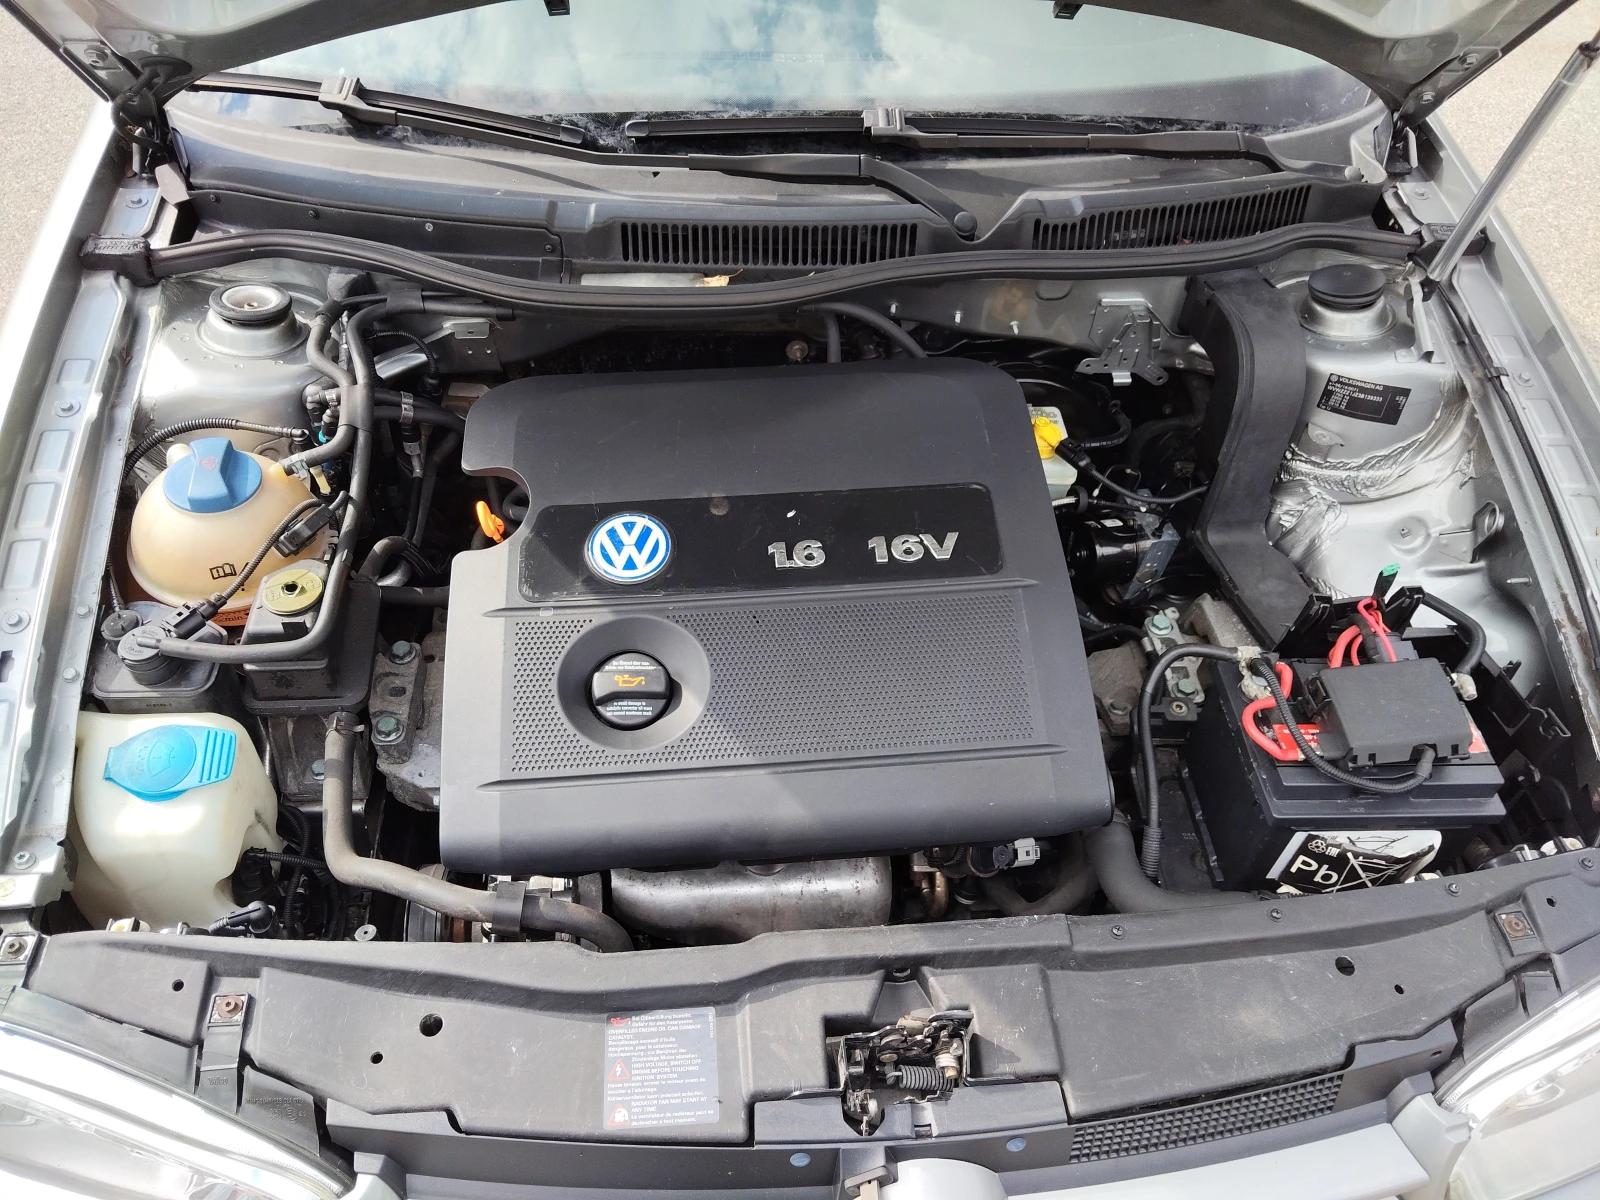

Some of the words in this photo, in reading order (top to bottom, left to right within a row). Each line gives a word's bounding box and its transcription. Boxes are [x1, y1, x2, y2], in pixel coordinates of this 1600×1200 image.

[1340, 377, 1375, 389] VOLKSWAGEN
[867, 531, 959, 563] 16V
[1290, 854, 1338, 885] Pb
